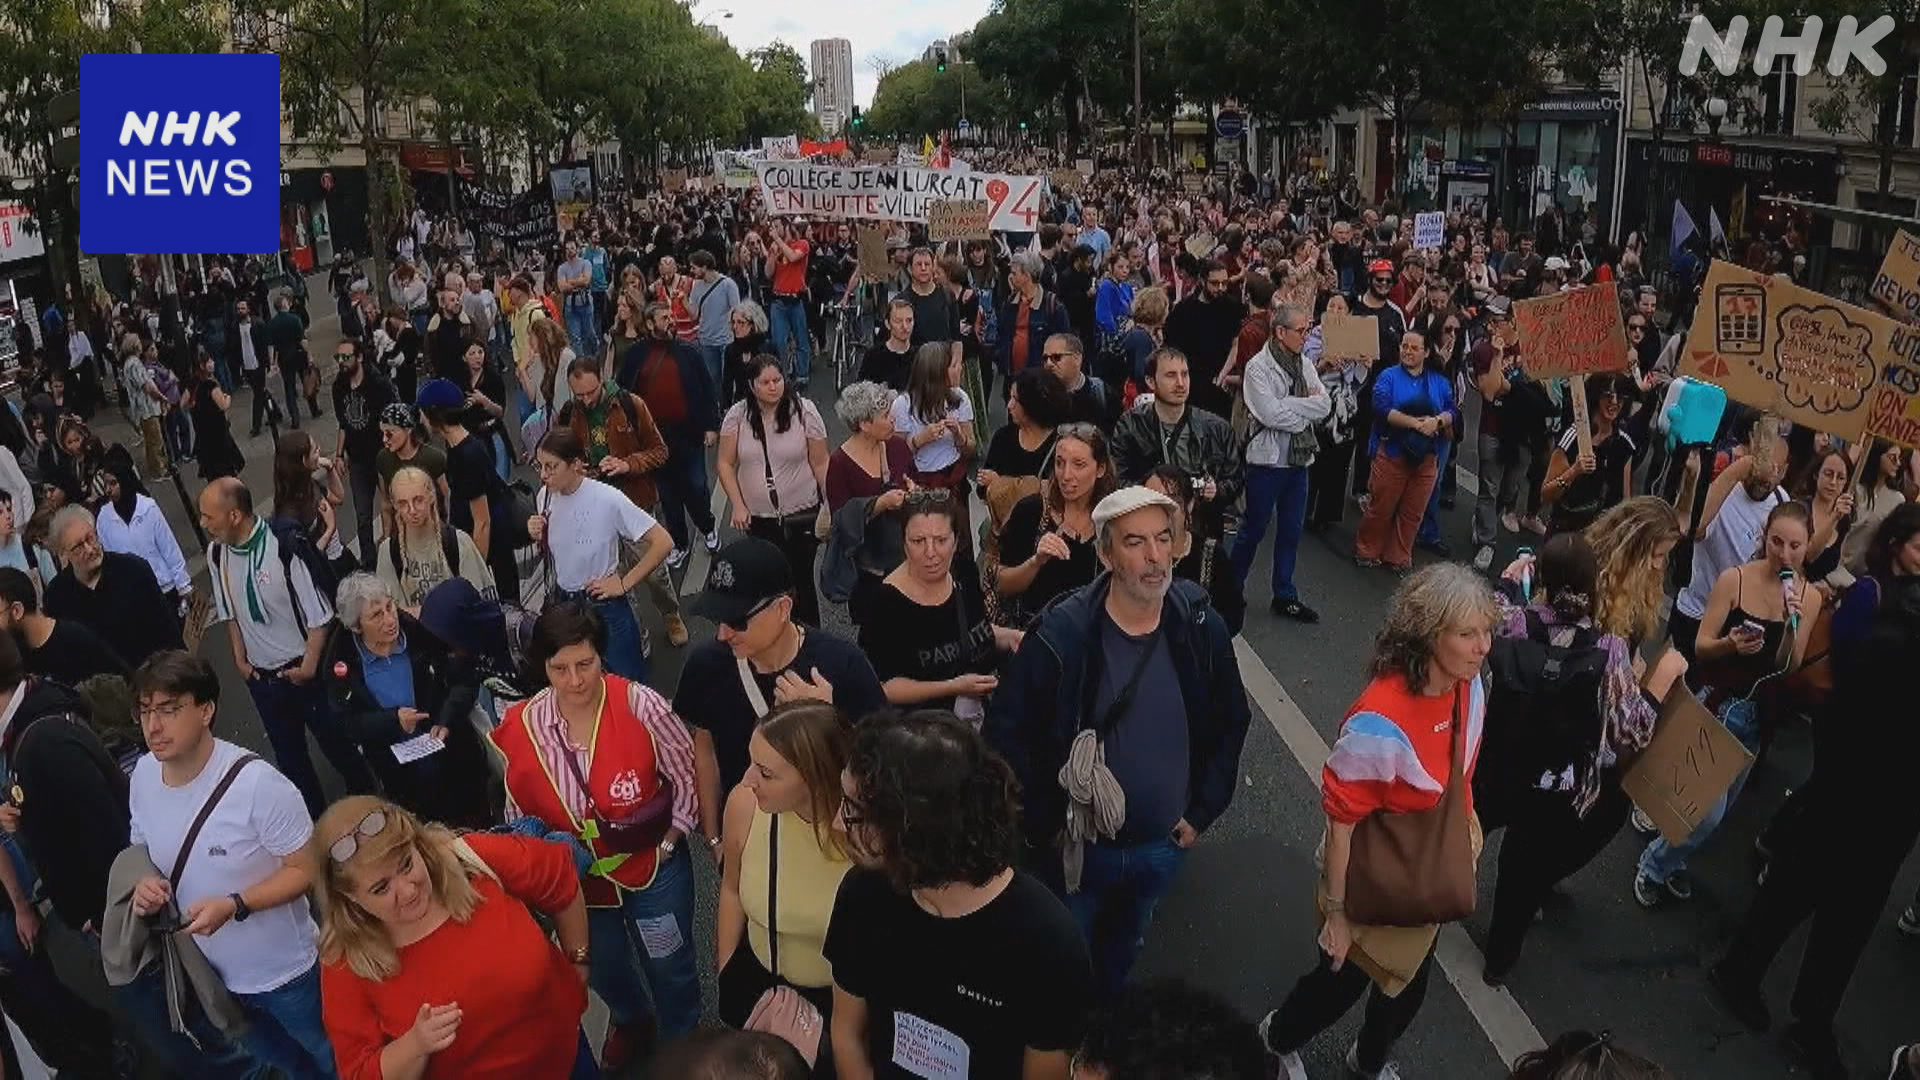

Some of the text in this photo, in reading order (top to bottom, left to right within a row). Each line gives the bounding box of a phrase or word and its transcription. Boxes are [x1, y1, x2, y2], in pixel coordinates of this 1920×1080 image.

[848, 170, 898, 190] JEAN
[903, 170, 983, 200] LURÇAT
[772, 189, 938, 218] EN LUTTE VILLE
[985, 178, 1040, 226] 94
